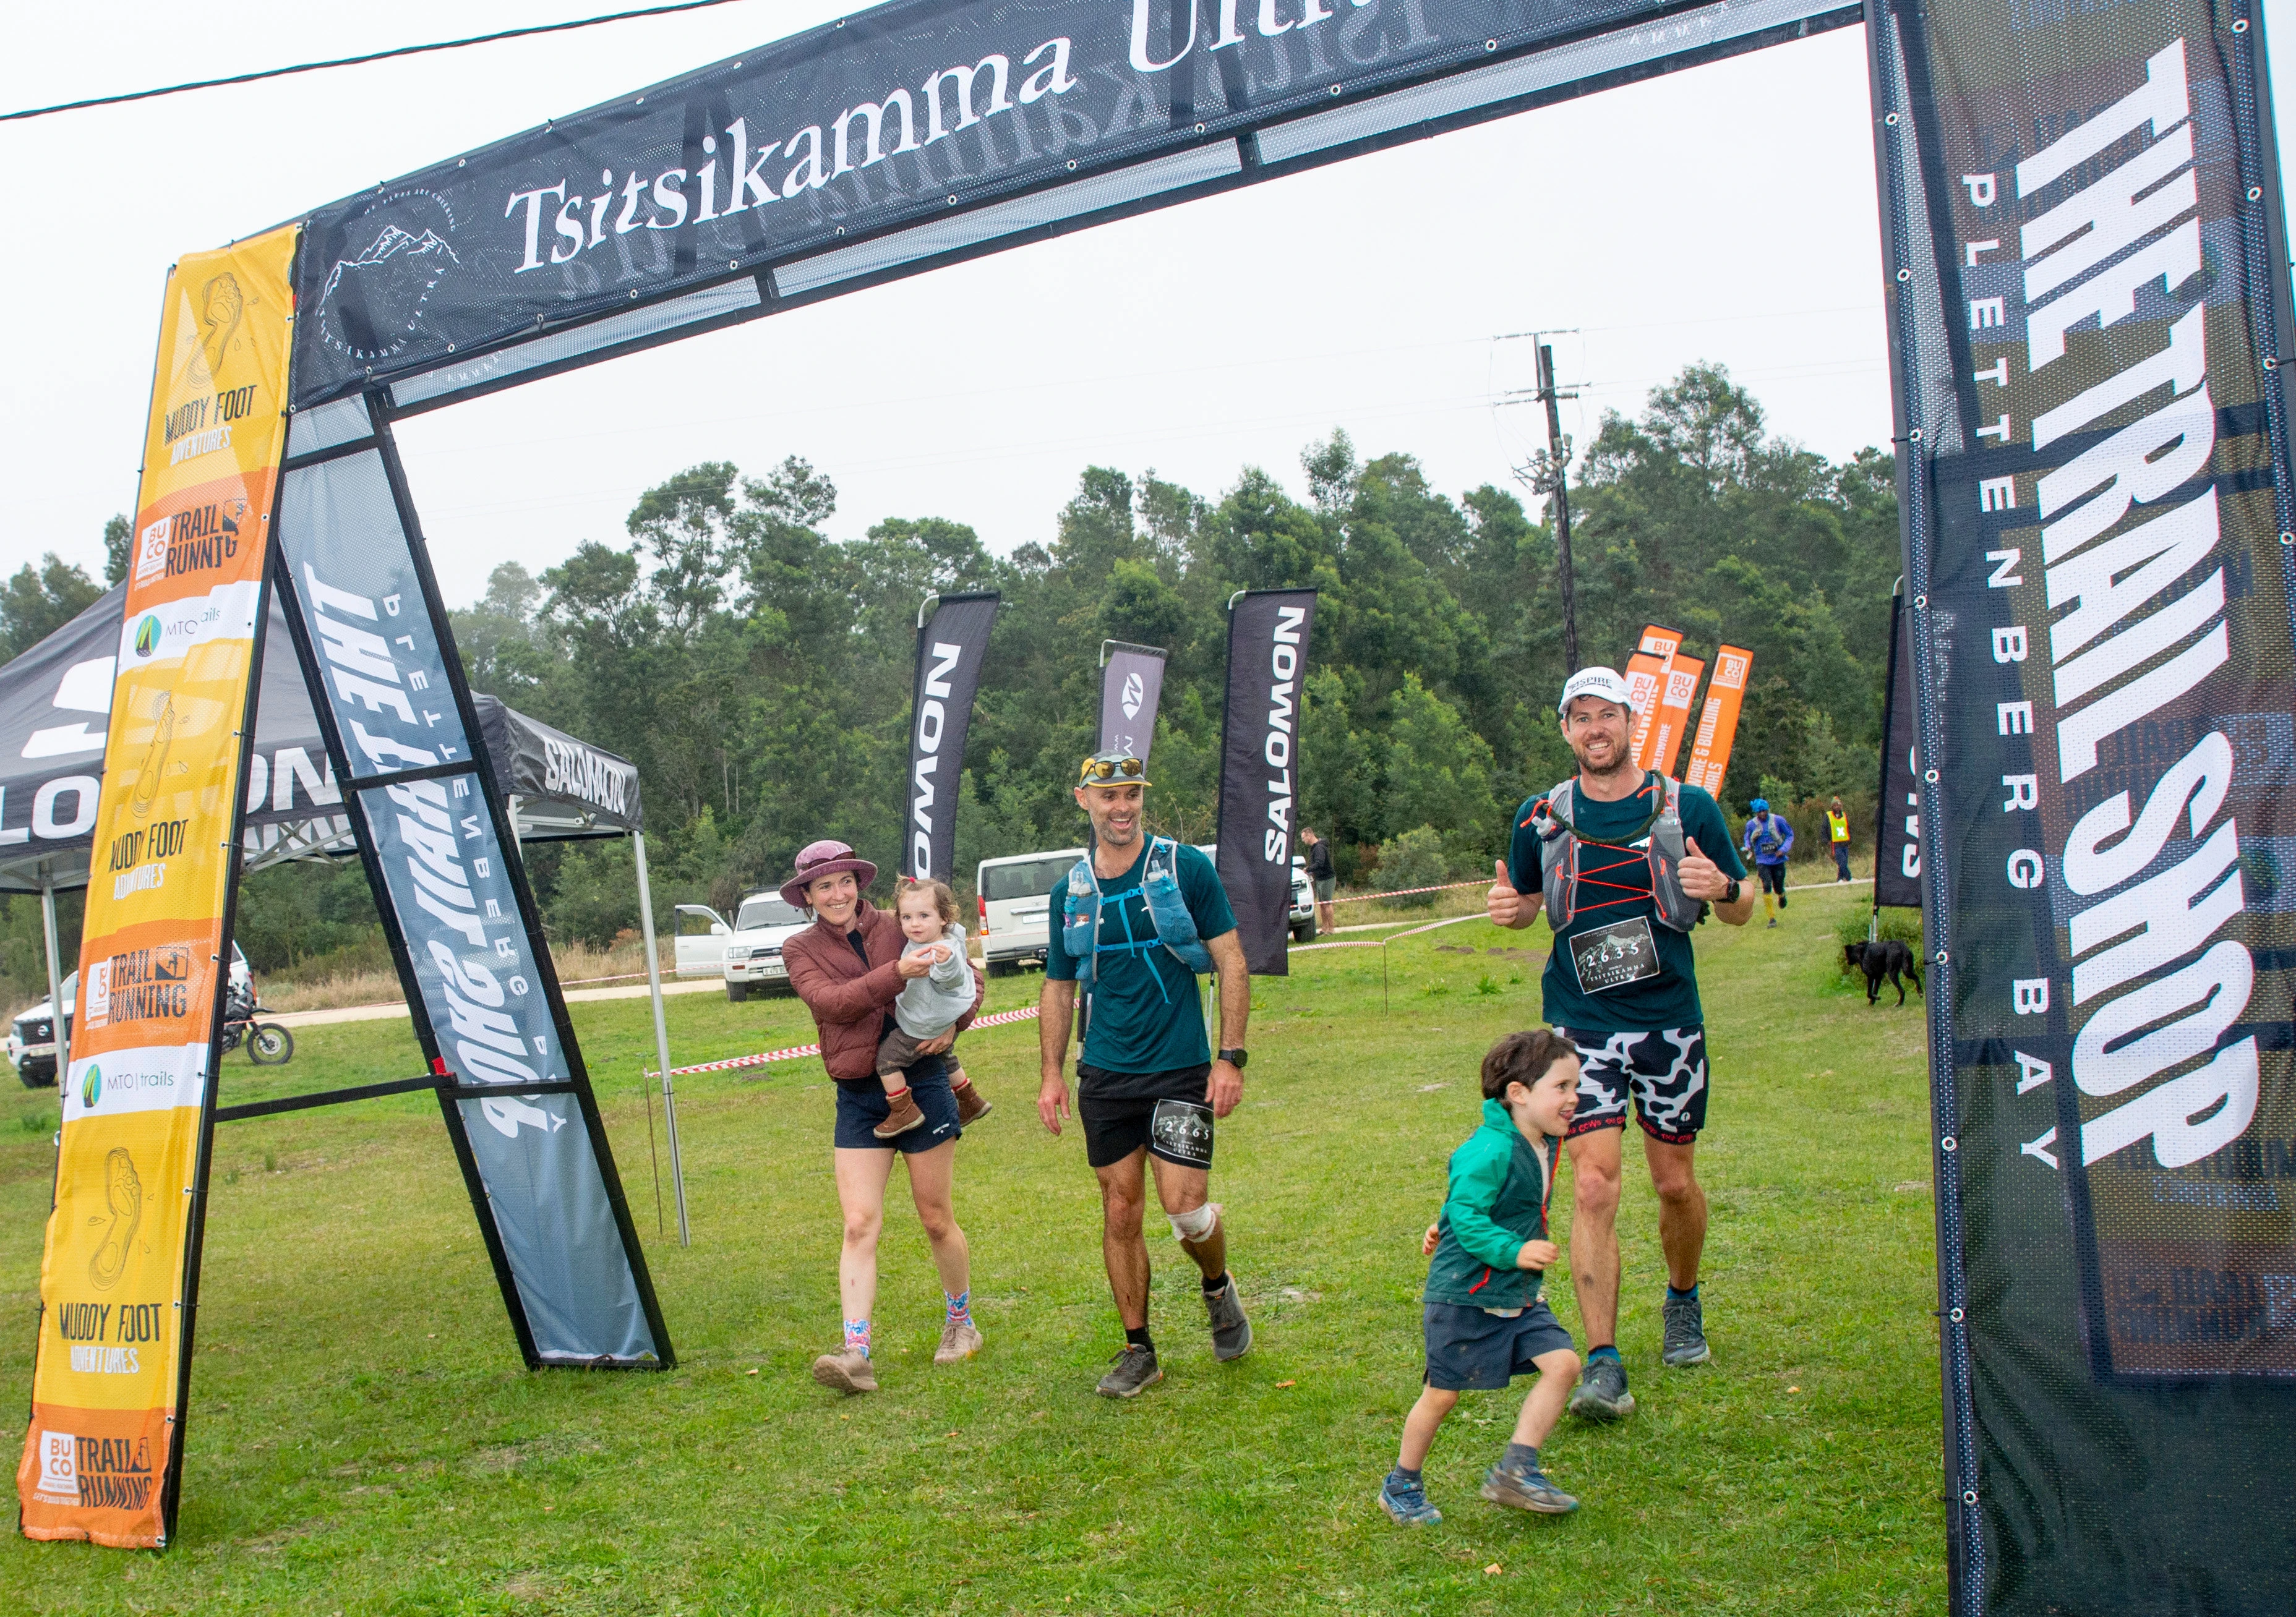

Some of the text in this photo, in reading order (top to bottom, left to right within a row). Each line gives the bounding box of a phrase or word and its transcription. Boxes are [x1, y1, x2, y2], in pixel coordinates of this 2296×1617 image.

[505, 36, 1077, 275] Tsitsikamma
[2016, 36, 2202, 372] THE
[165, 385, 257, 445] MUDDY FOOT
[149, 522, 166, 543] BU
[170, 503, 219, 544] TRAIL
[147, 541, 166, 560] CO
[2031, 301, 2229, 783] TRAIL
[1653, 641, 1673, 652] BU
[1726, 659, 1741, 669] BU
[1634, 677, 1651, 689] BU
[1673, 675, 1692, 686] BU
[1724, 668, 1740, 678] CO
[1962, 173, 2059, 1169] PLETTENBERG BAY
[1671, 686, 1689, 698] CO
[1265, 606, 1305, 866] SALOMON
[1697, 697, 1721, 747] BUILDING
[914, 642, 961, 880] OMON
[1652, 723, 1671, 770] UILDWARE
[542, 735, 626, 816] SALOMON
[1687, 757, 1708, 788] WARE
[147, 819, 189, 860] FOOT
[1587, 943, 1639, 966] 2635
[2063, 731, 2261, 1168] SHOP
[111, 948, 152, 988] TRAIL
[1590, 963, 1645, 981] TSITSIKAMMA
[1604, 973, 1630, 983] ULTRA
[108, 984, 186, 1025] RUNNING
[107, 1072, 174, 1091] MTO trails
[1165, 1121, 1209, 1140] 2665
[59, 1303, 163, 1342] MUDDY FOOT
[51, 1438, 71, 1456] BU
[76, 1436, 130, 1473] TRAIL
[51, 1458, 72, 1476] CO
[78, 1475, 152, 1511] RUNNING
